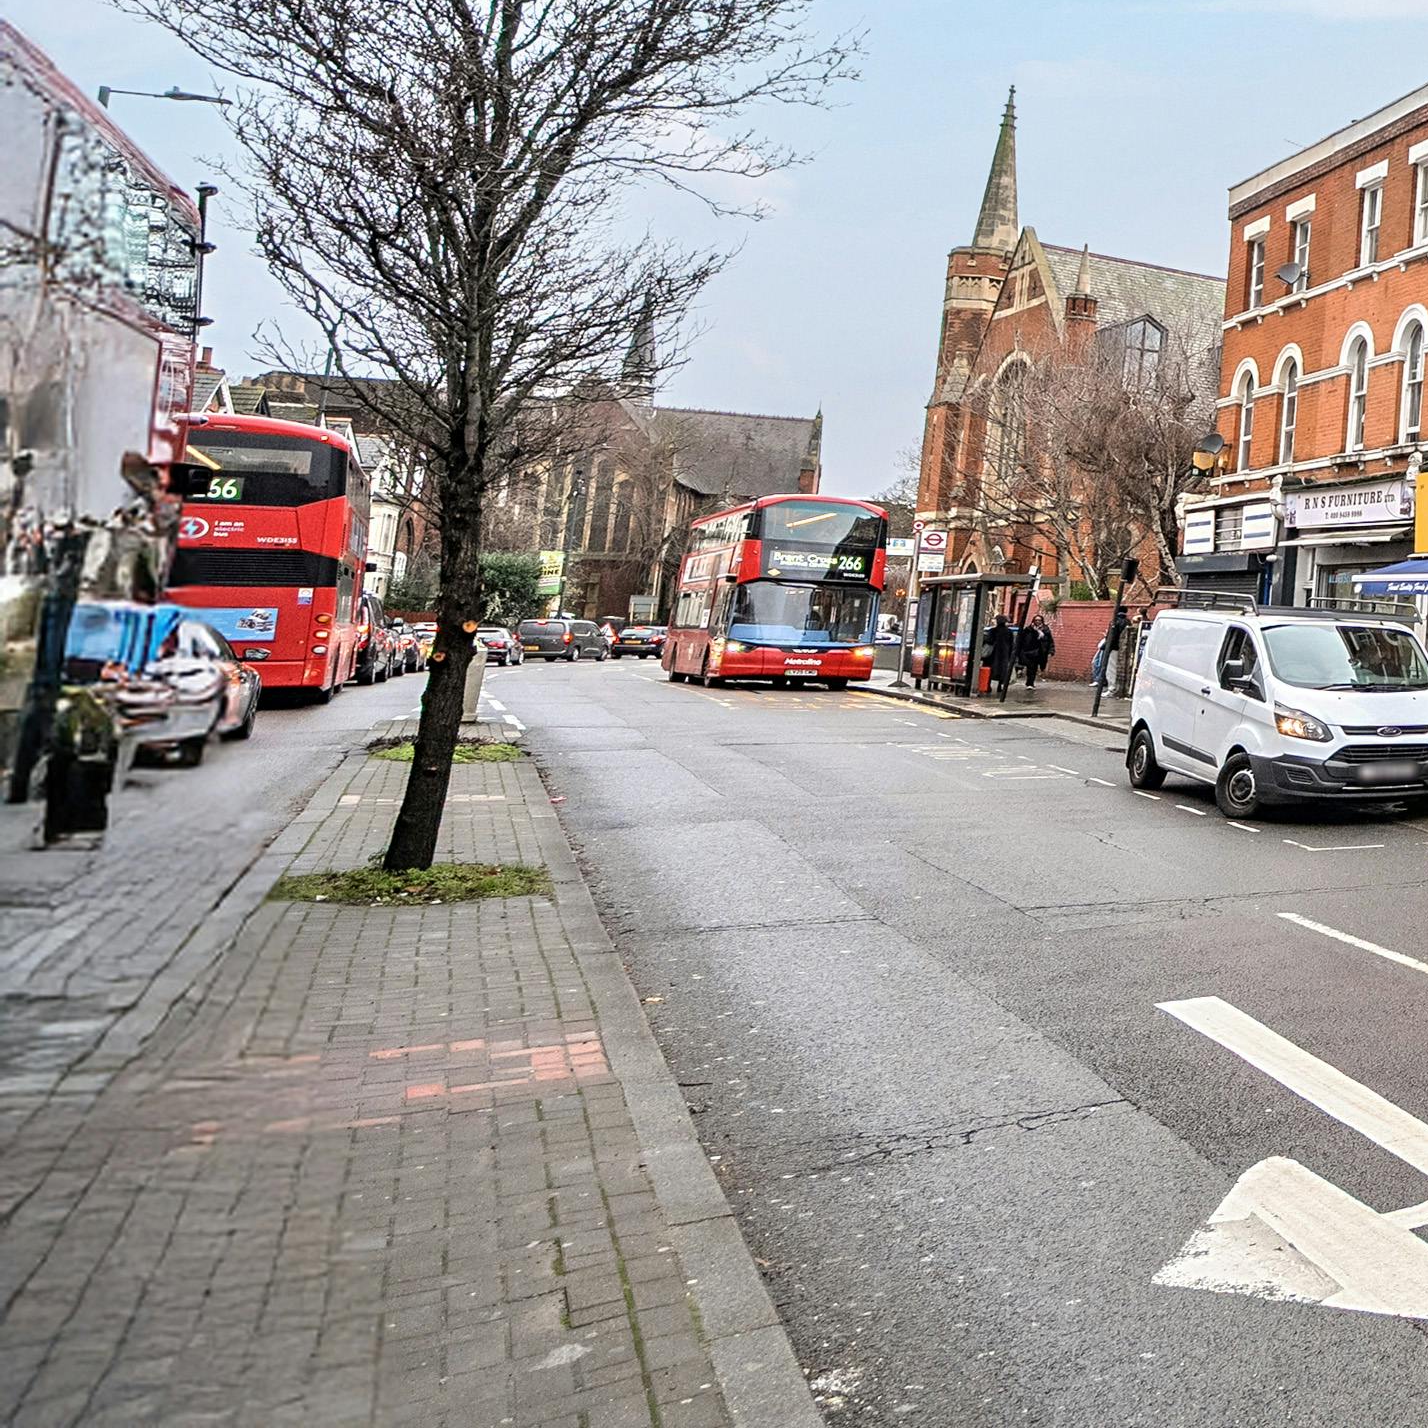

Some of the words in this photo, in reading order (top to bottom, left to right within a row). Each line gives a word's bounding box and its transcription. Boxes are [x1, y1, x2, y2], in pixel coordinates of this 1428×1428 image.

[1304, 498, 1311, 510] R
[1312, 497, 1319, 509] N
[1320, 496, 1327, 509] S
[1328, 490, 1383, 508] FURNITURE
[774, 551, 805, 563] Brent
[839, 556, 862, 571] 266
